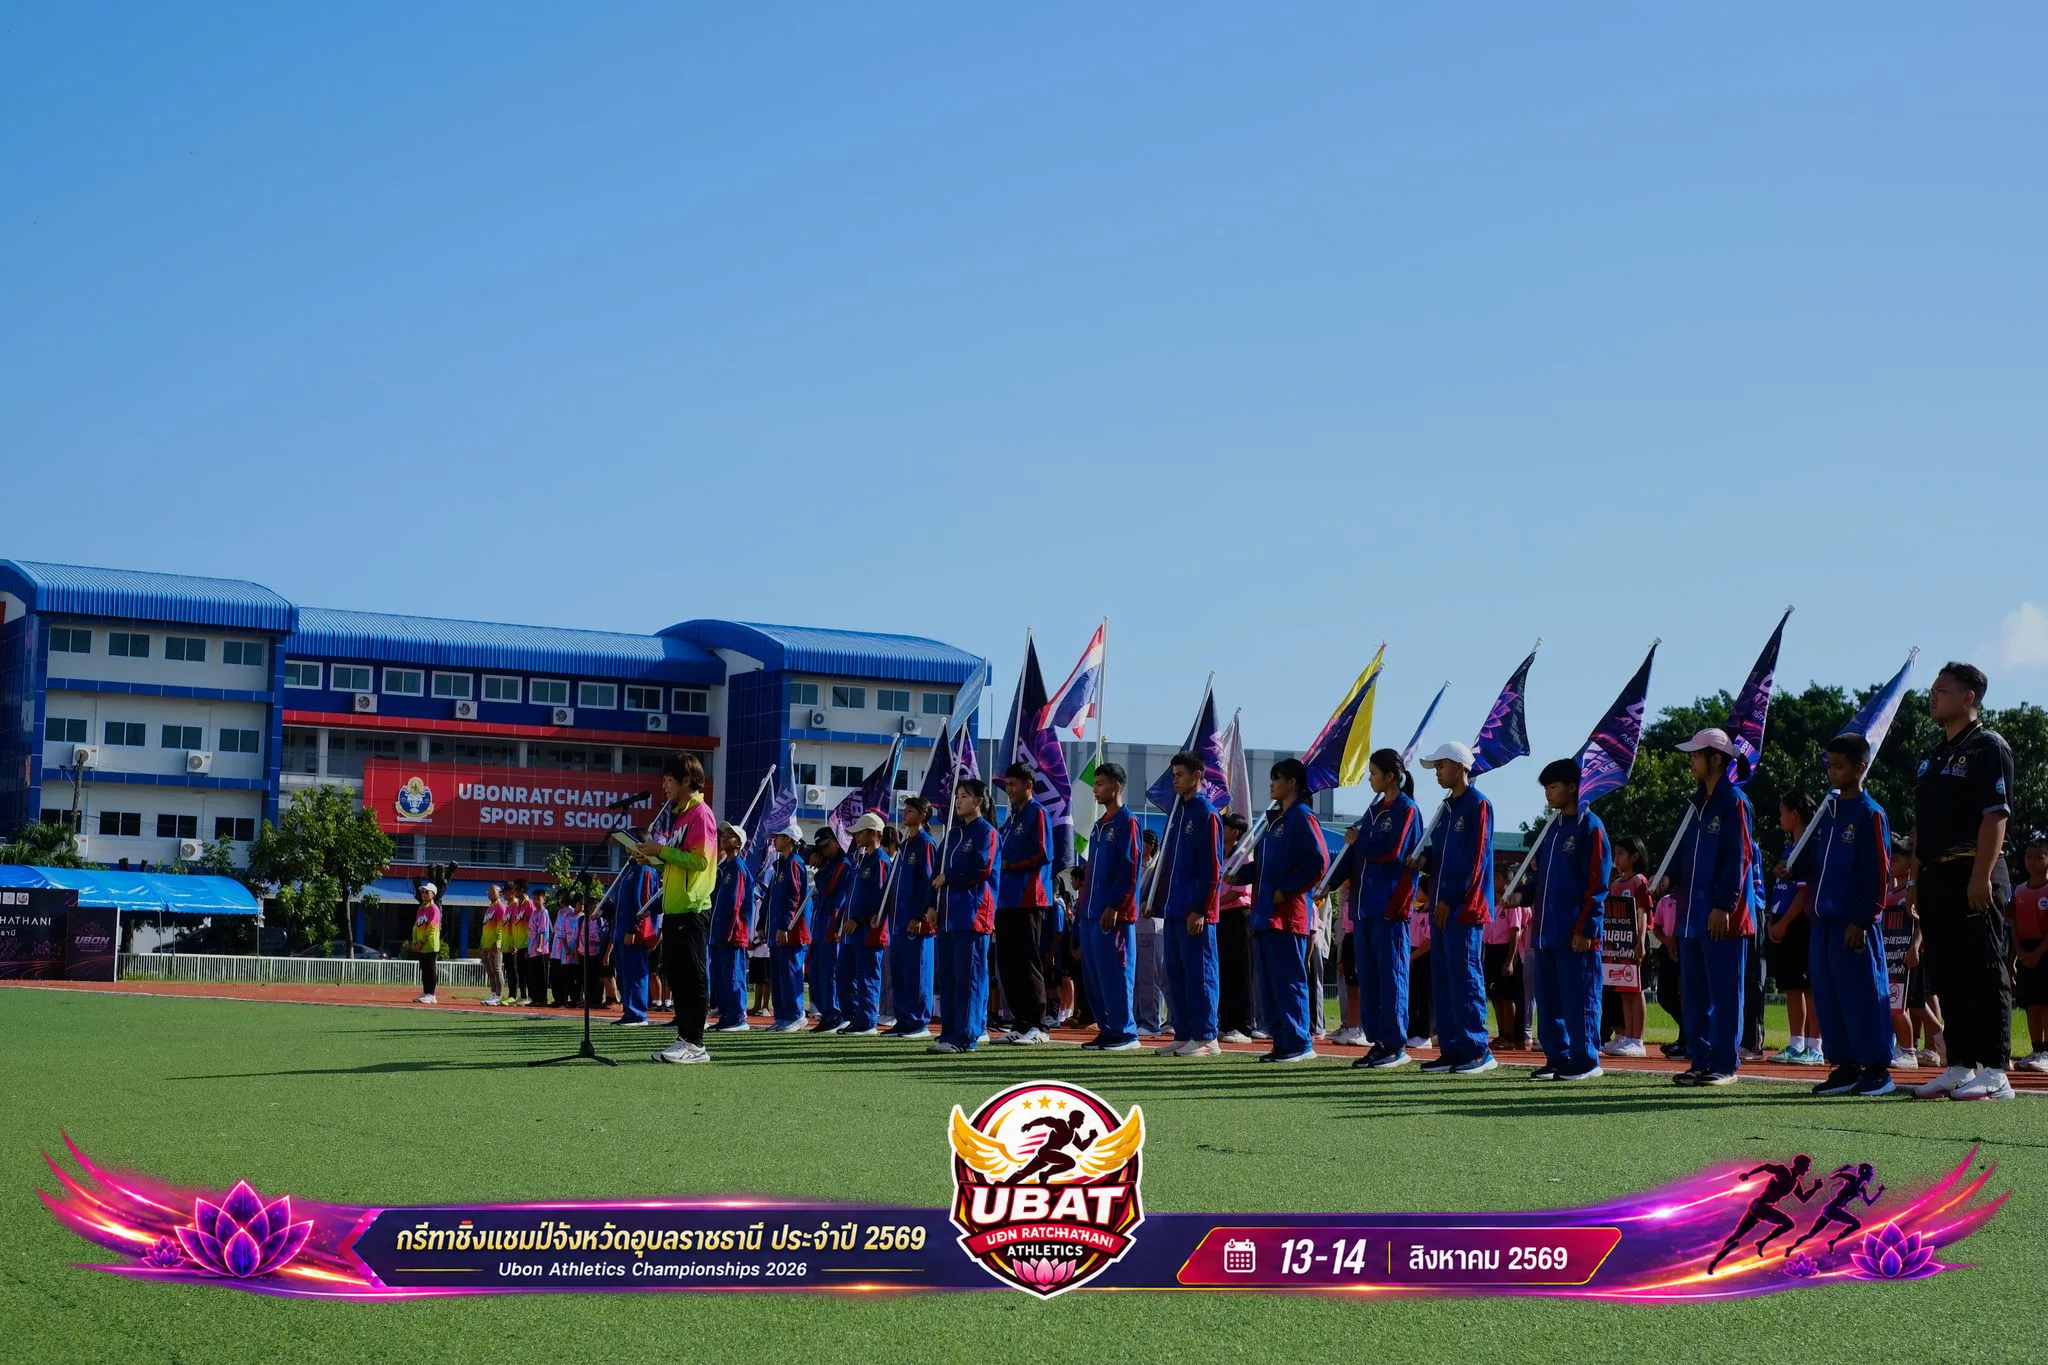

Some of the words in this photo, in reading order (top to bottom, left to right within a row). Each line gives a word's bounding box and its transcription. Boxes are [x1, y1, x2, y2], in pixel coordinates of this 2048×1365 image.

[458, 783, 653, 809] UBONRATCHATHANI
[480, 807, 553, 827] SPORTS
[564, 811, 637, 829] SCHOOL
[74, 936, 110, 945] UBON
